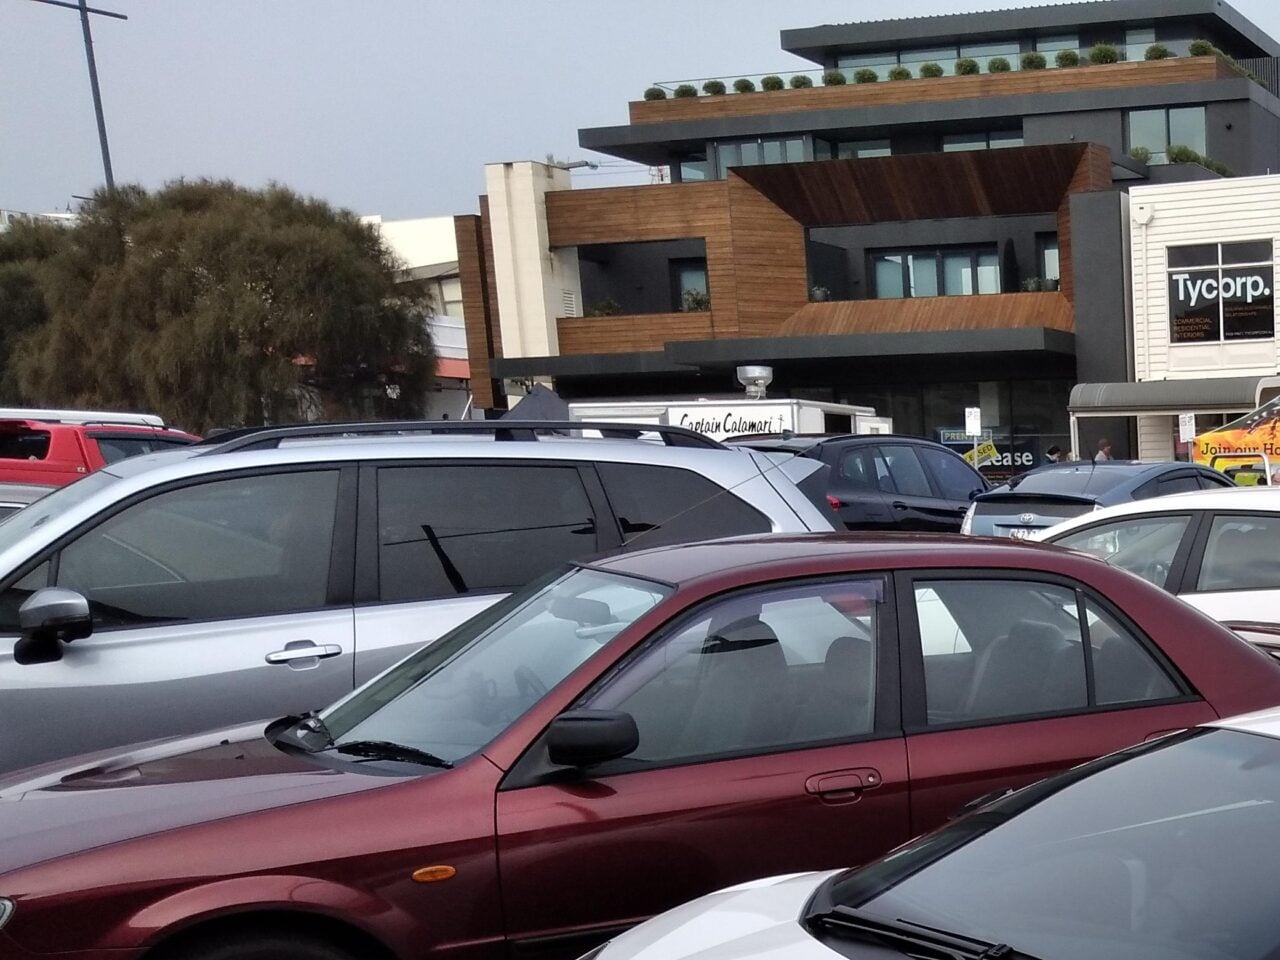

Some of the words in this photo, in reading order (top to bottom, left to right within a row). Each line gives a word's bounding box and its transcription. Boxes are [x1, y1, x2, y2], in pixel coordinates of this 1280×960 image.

[1172, 273, 1270, 307] Tycorp.
[680, 413, 721, 434] Captain
[723, 412, 773, 434] Calamari
[1201, 442, 1231, 455] Join
[1235, 446, 1259, 454] our
